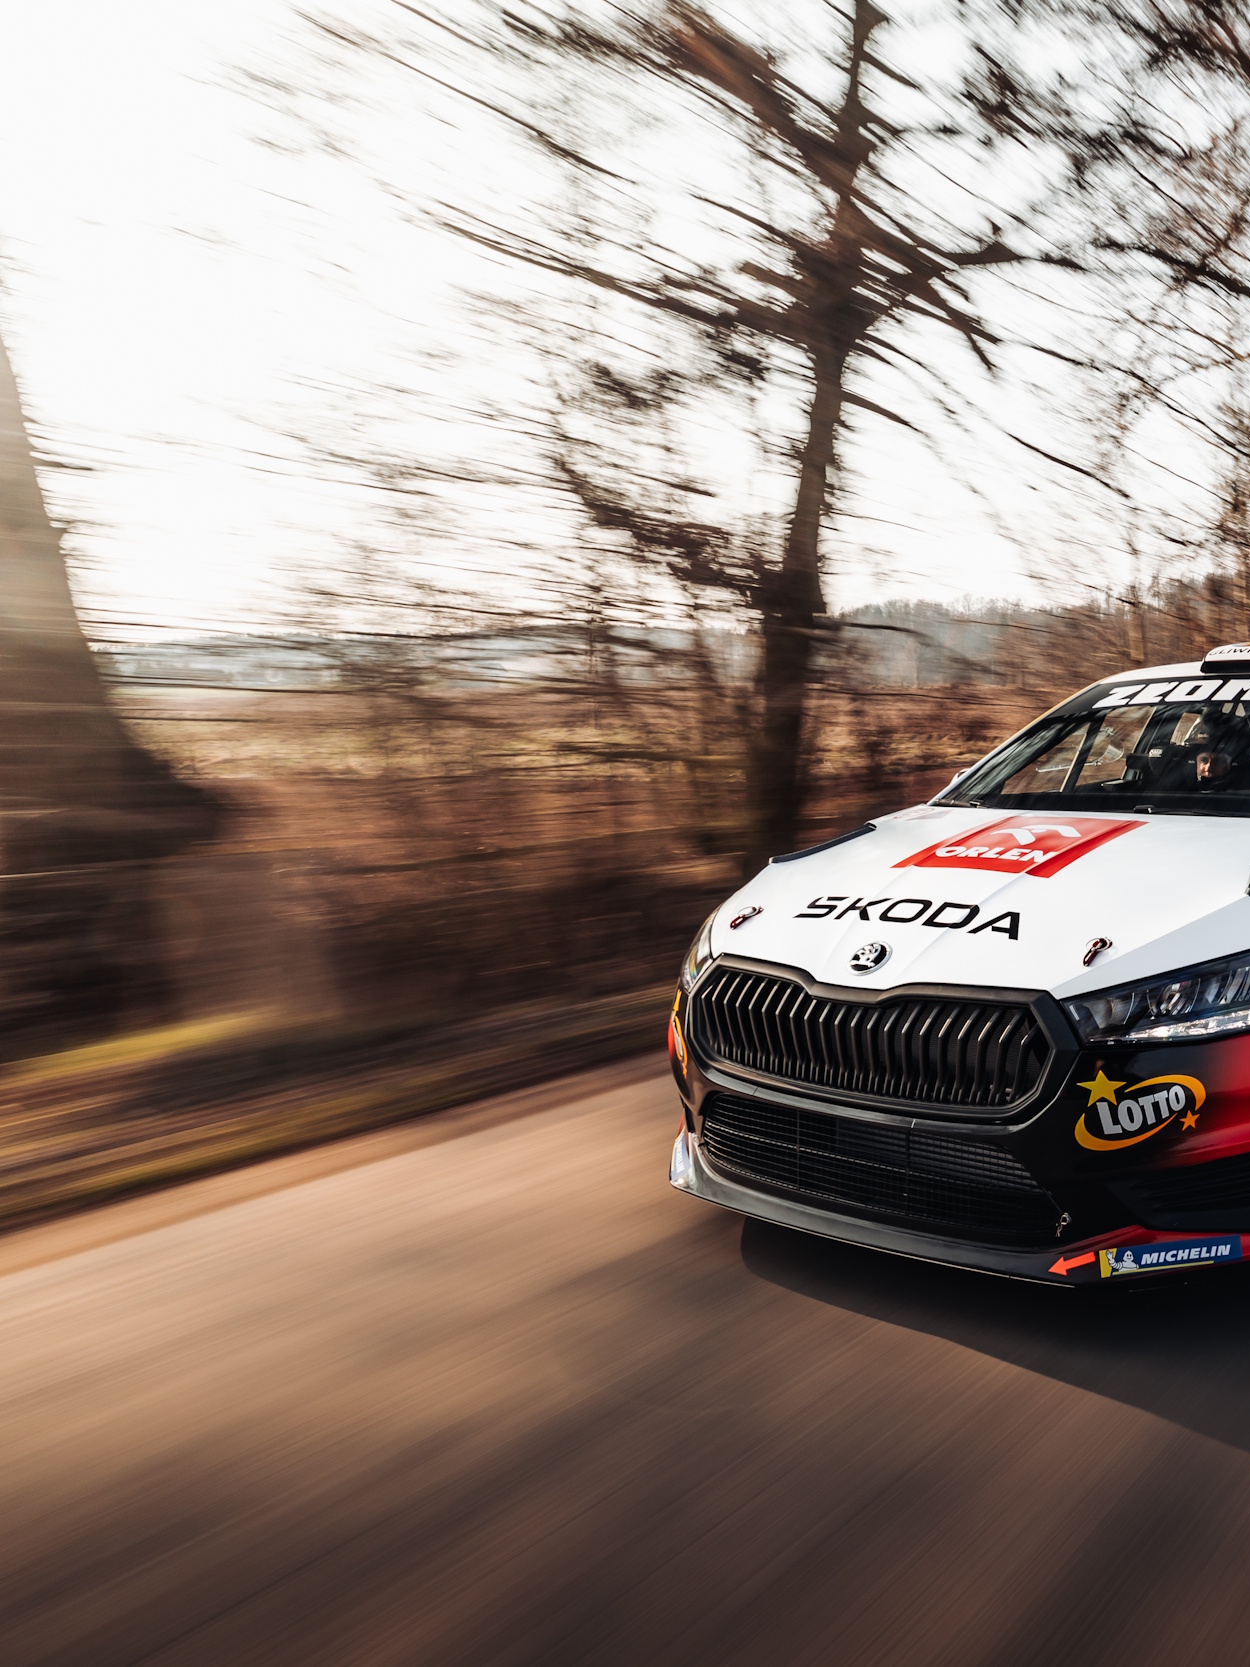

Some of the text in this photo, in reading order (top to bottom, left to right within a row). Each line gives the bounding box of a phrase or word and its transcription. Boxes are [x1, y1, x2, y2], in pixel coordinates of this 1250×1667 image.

[935, 846, 1058, 863] ORLEN
[1096, 1085, 1186, 1135] LOTTO
[1140, 1244, 1231, 1265] MICHELIN
